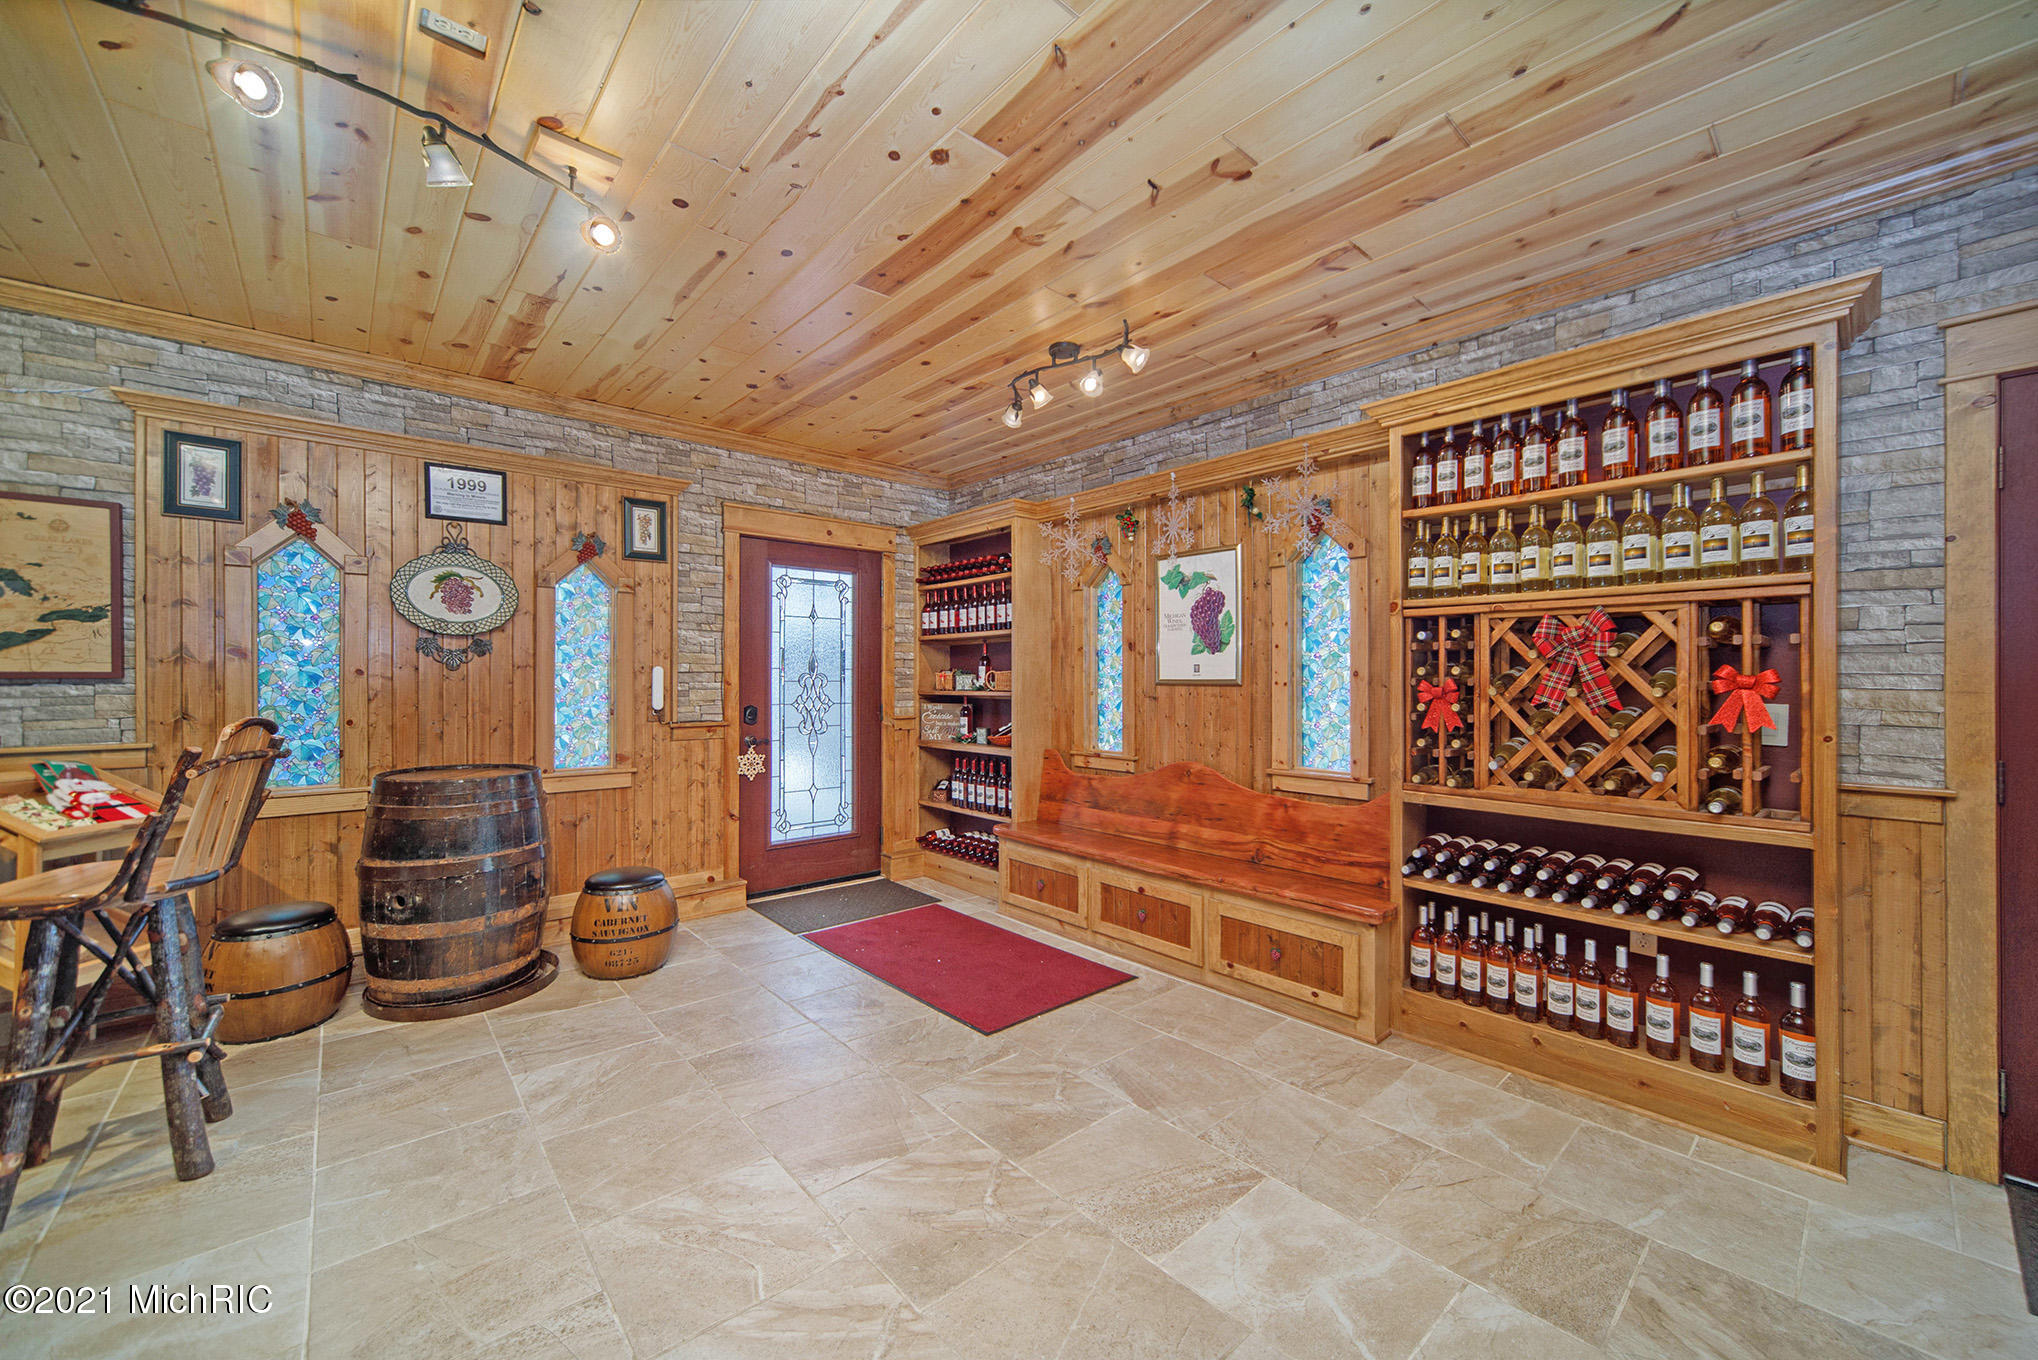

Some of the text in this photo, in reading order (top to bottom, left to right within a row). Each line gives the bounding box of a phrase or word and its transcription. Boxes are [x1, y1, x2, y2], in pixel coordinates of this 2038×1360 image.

[447, 476, 487, 493] 1999
[604, 896, 639, 912] VIN
[594, 914, 648, 927] CABERNET
[592, 925, 649, 937] SAUVIGNON
